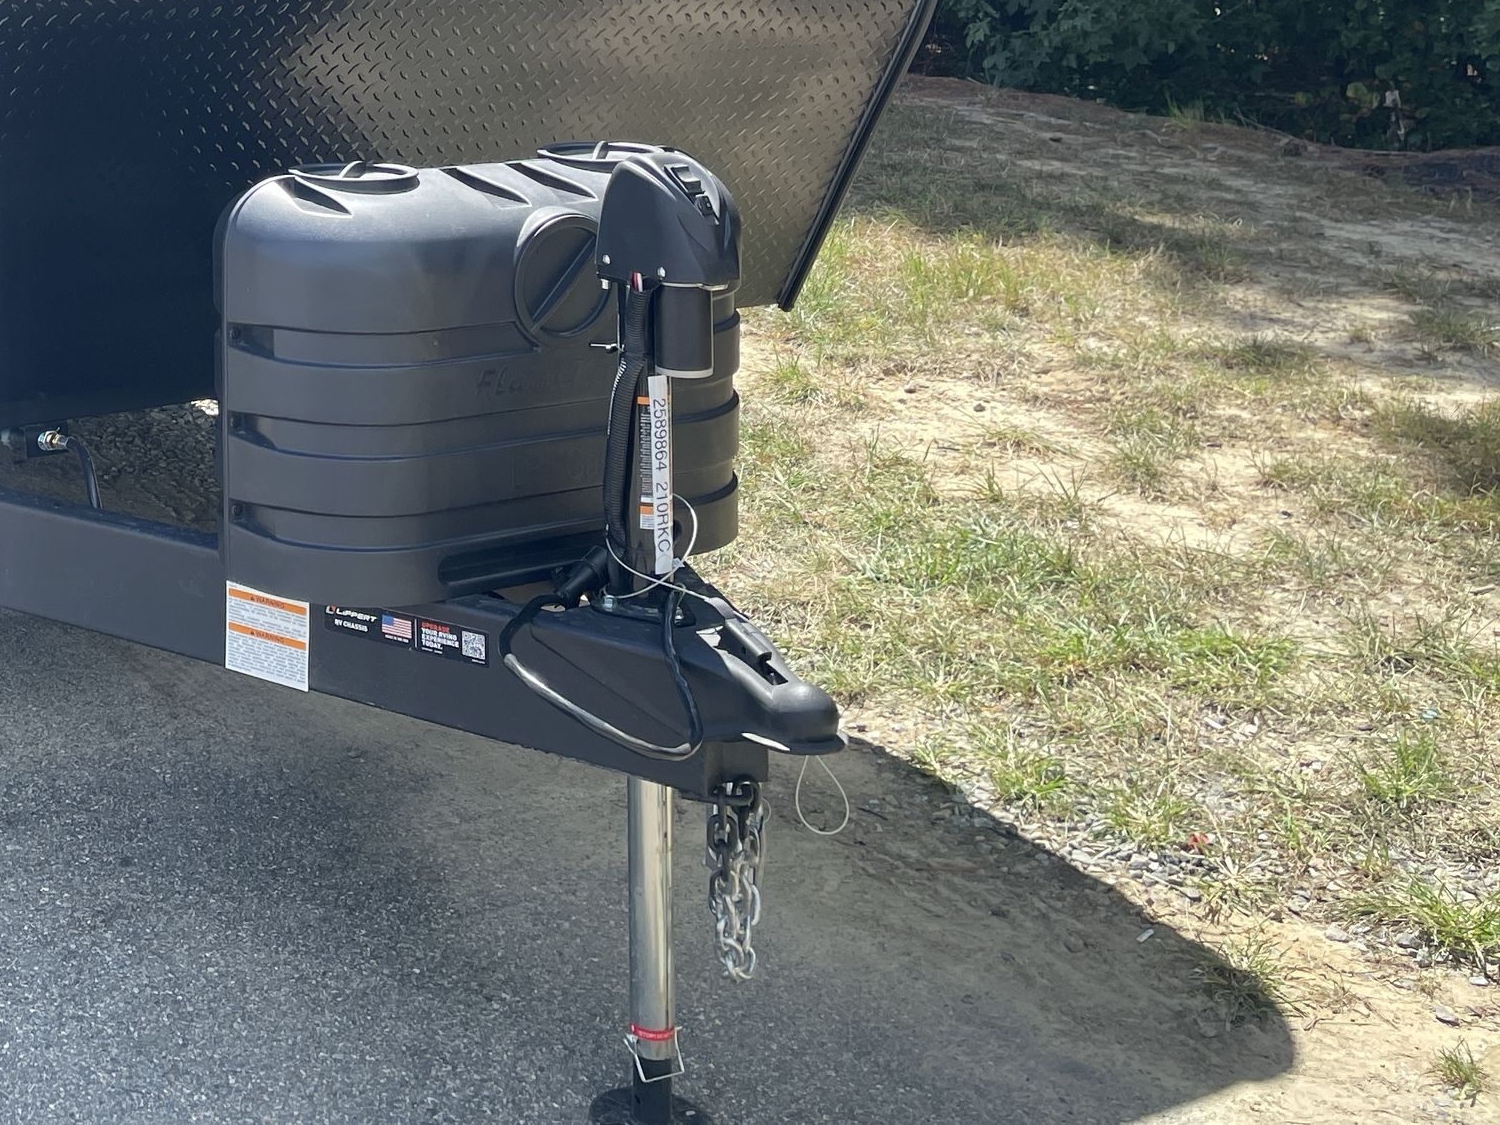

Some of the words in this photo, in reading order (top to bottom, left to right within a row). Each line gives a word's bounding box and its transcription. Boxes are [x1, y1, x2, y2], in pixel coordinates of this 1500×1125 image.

[653, 398, 667, 471] 2589864
[656, 481, 671, 552] 210RKC
[336, 608, 377, 623] LIPPERT
